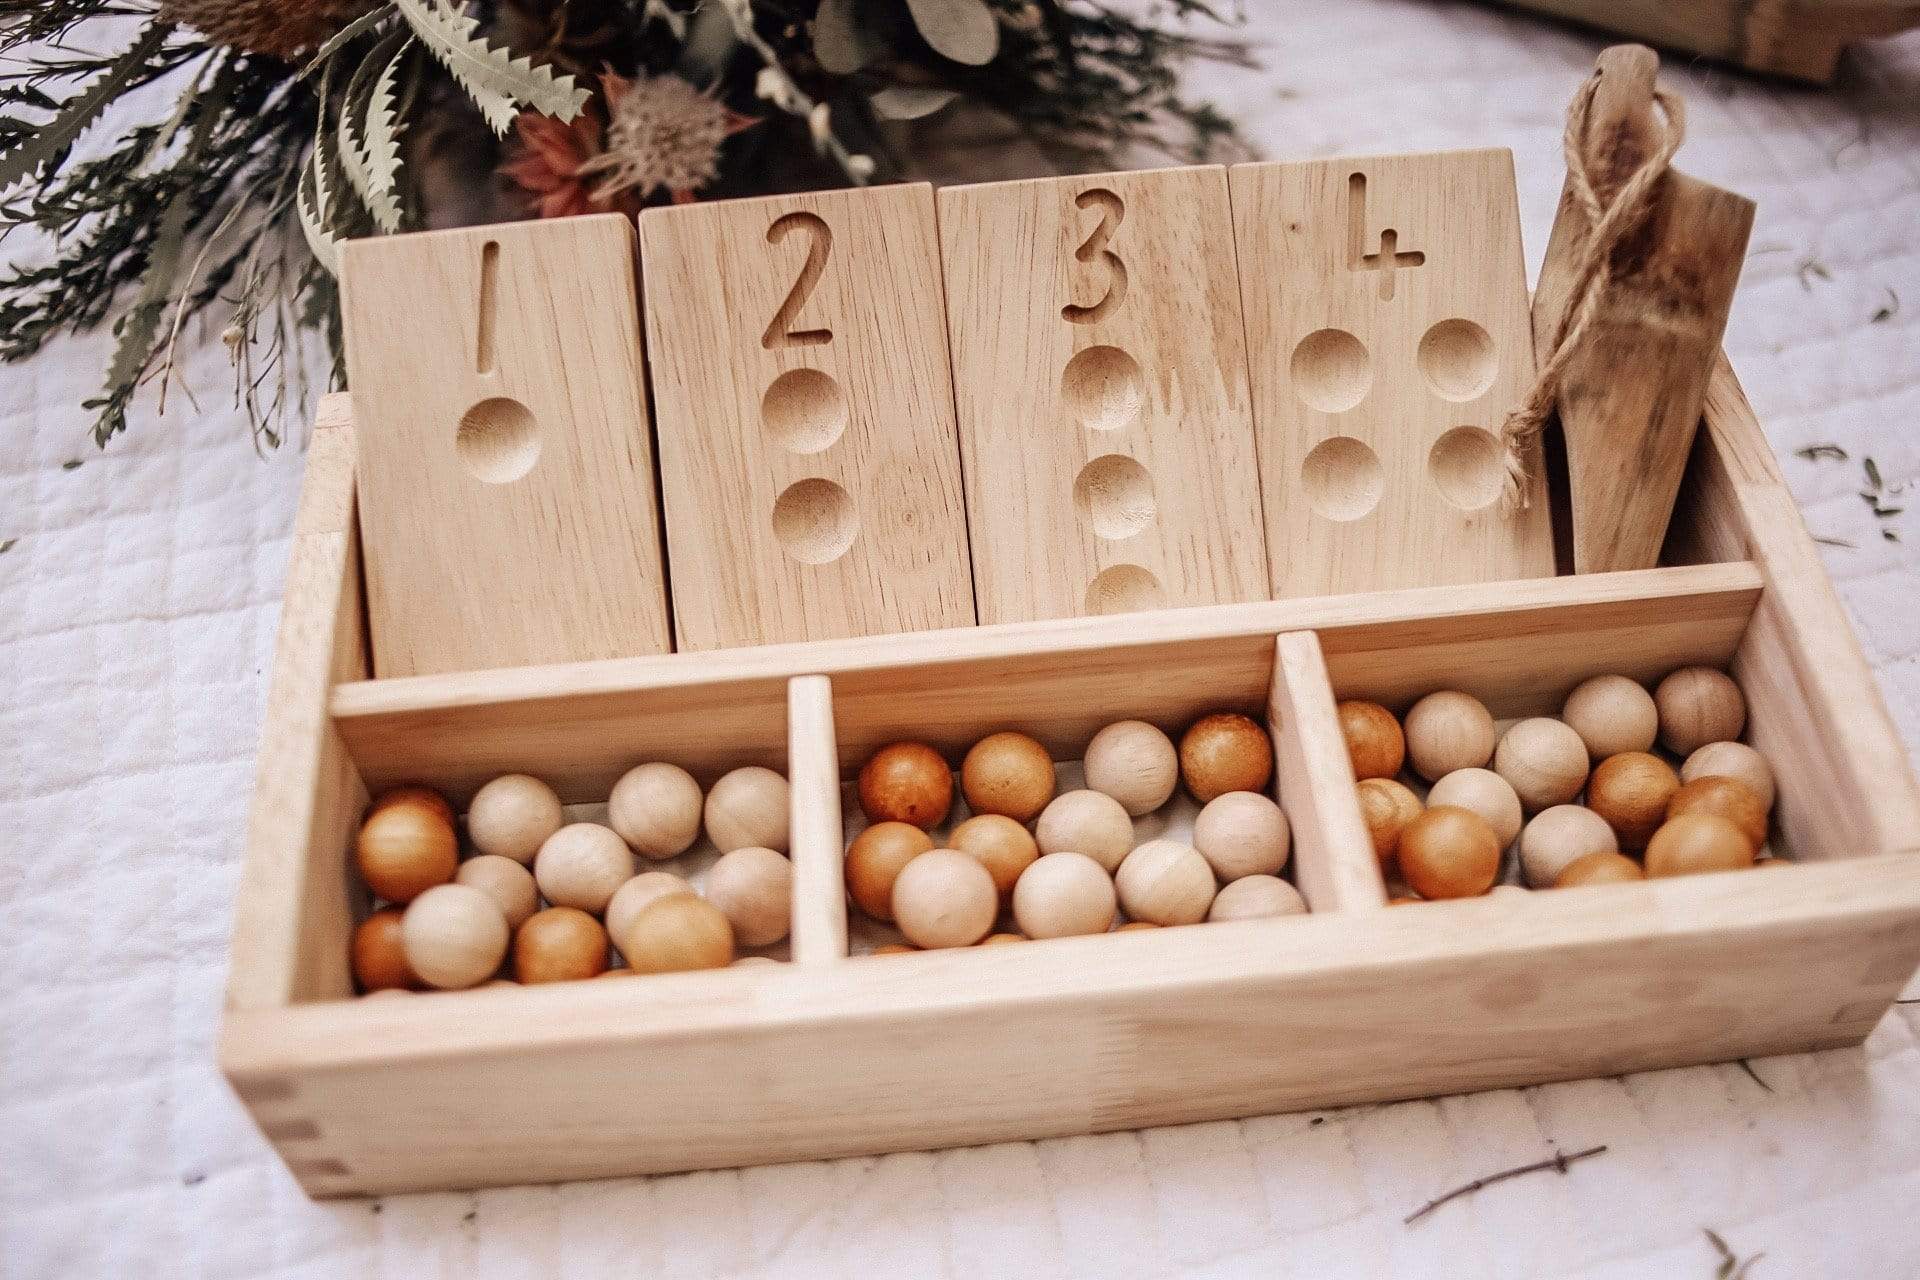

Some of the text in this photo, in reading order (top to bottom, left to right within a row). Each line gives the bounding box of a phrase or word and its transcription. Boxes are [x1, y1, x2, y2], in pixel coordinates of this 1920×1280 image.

[761, 210, 834, 350] 2
[1061, 187, 1129, 325] 3
[1348, 171, 1426, 300] 4
[476, 240, 500, 375] 1
